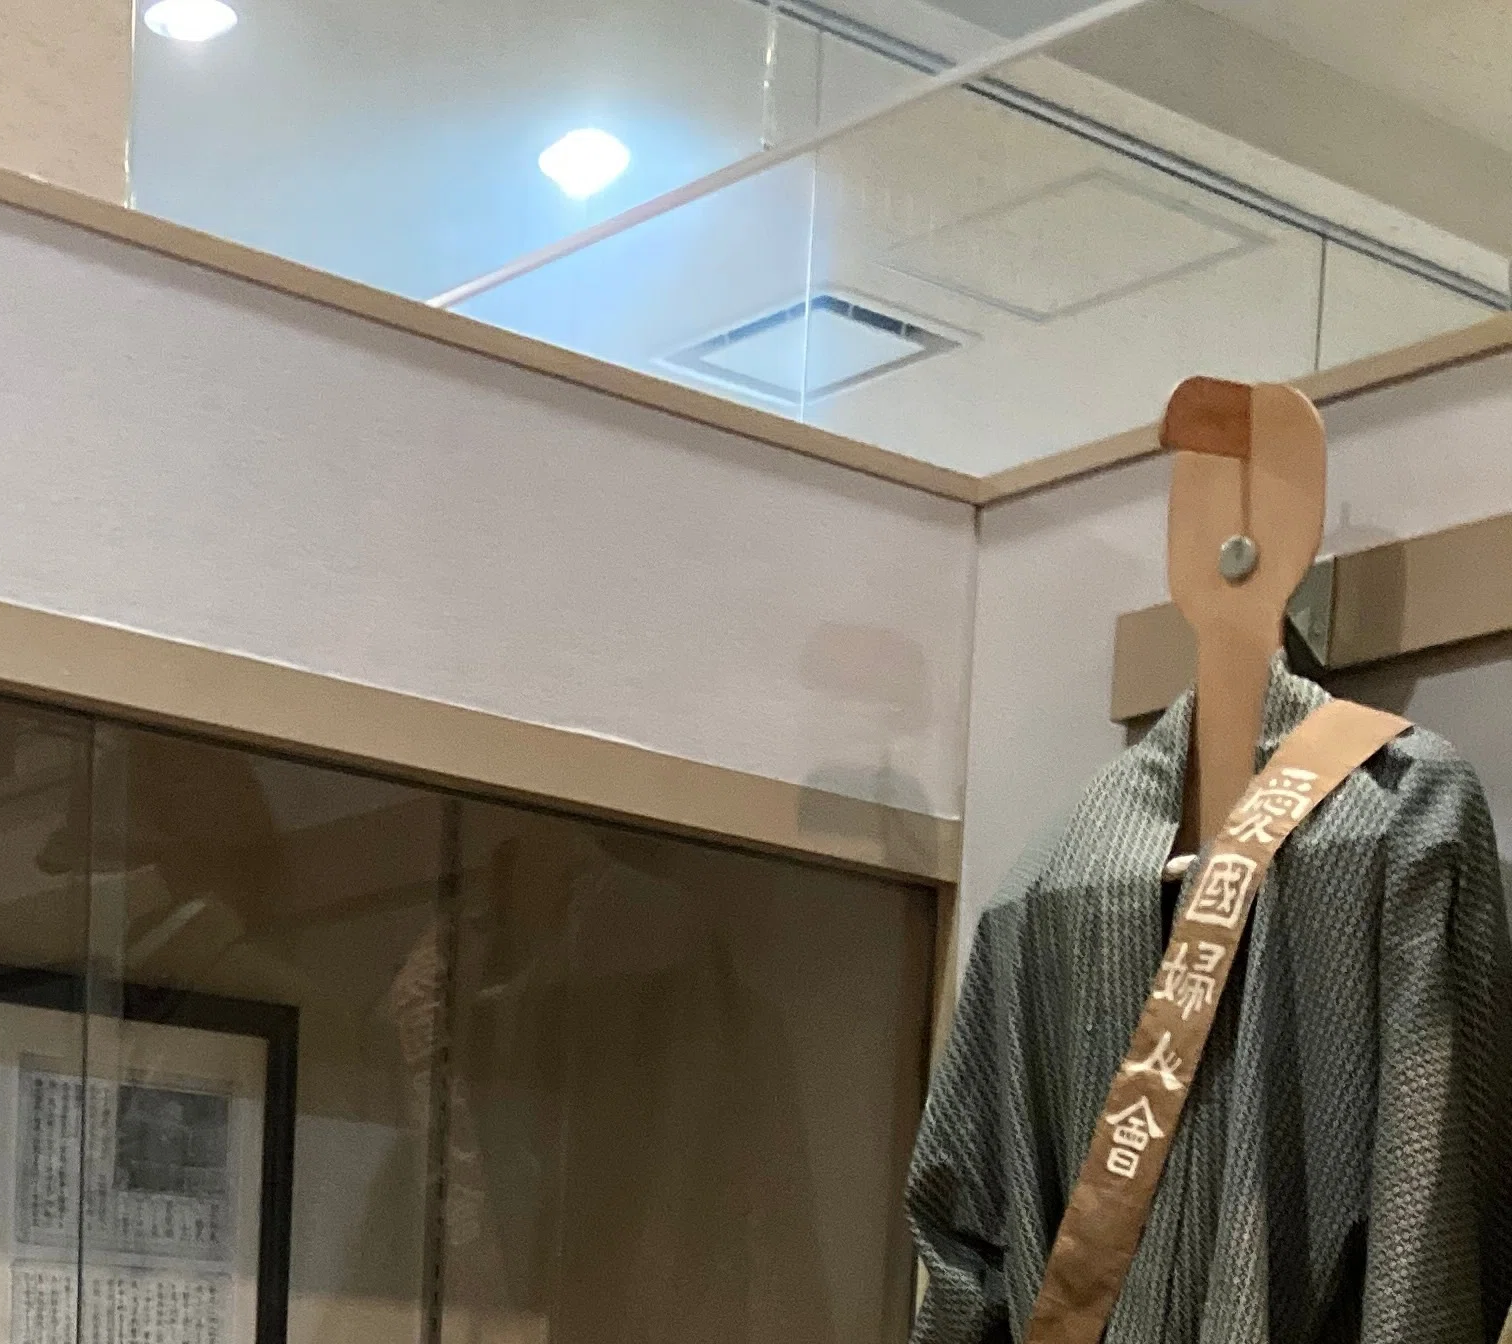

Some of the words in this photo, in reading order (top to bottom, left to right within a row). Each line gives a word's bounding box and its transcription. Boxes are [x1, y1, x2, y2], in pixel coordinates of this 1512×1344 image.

[1107, 766, 1318, 1180] 愛國婦人會
